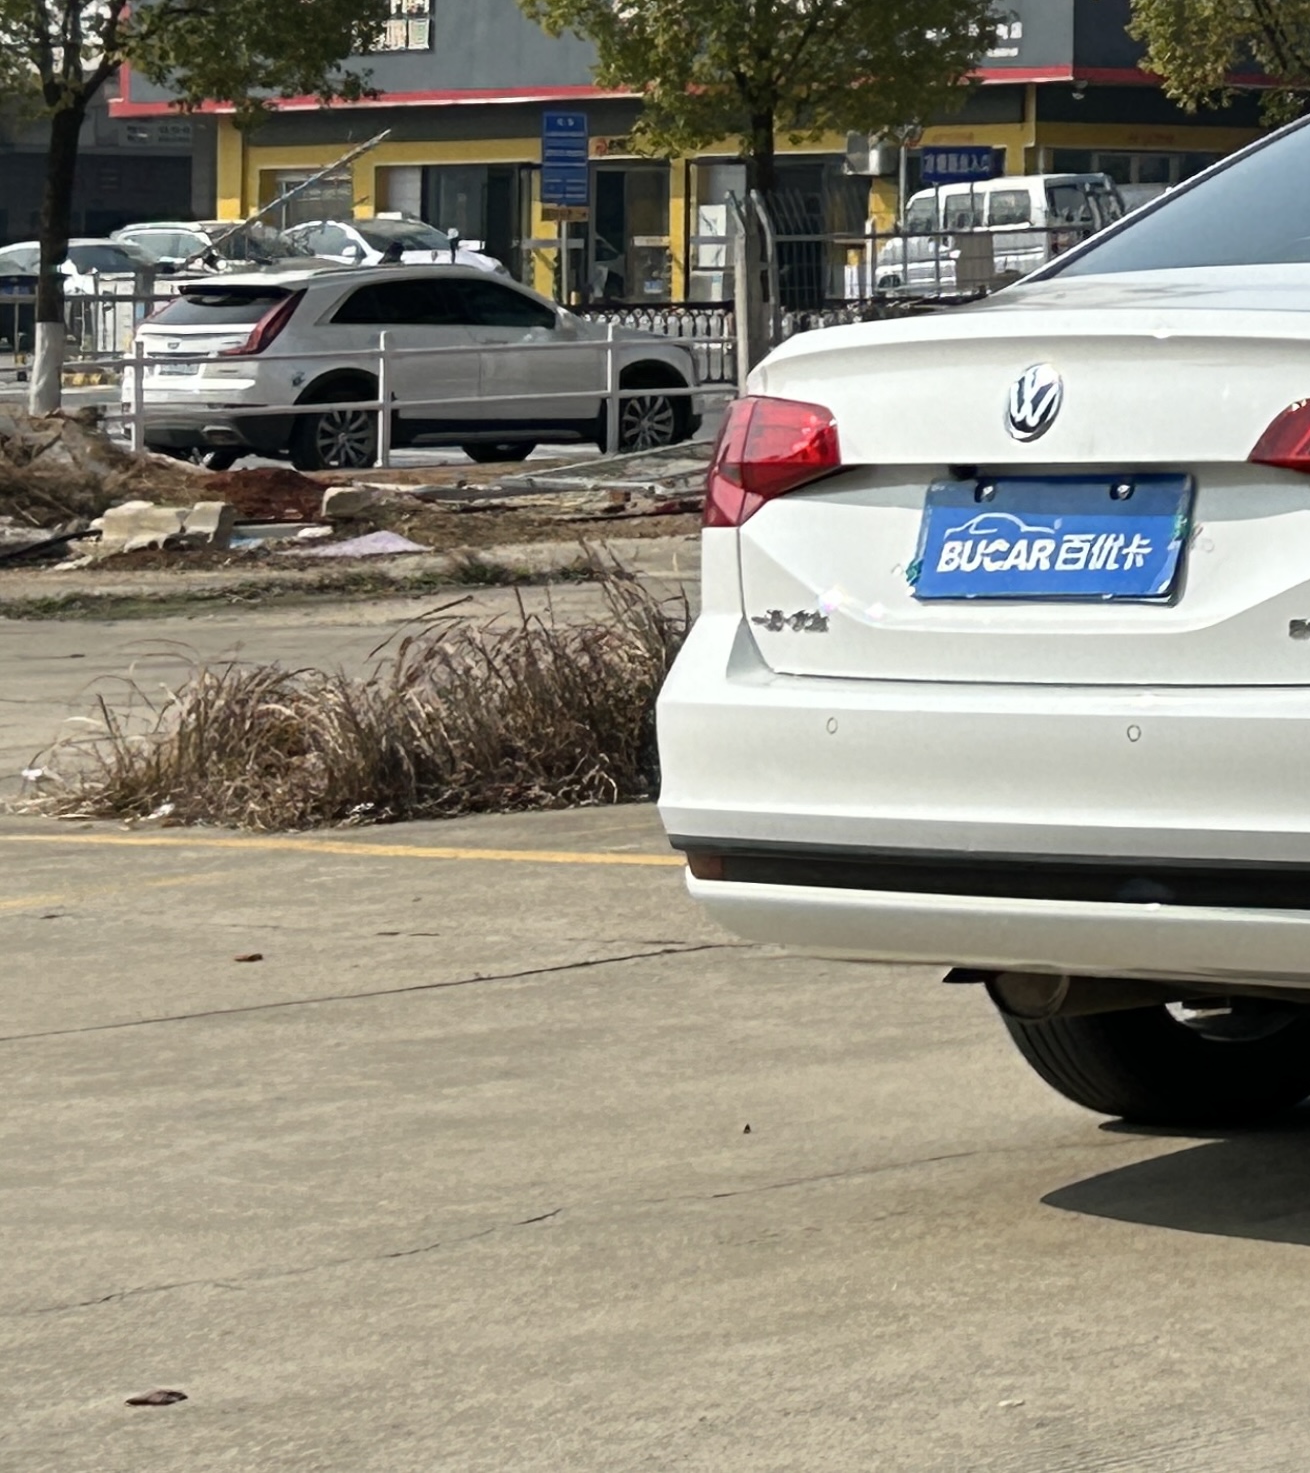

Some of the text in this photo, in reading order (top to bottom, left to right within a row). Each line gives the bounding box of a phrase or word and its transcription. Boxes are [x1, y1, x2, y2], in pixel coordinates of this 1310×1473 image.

[937, 533, 1153, 573] BUCAR 百优卡
